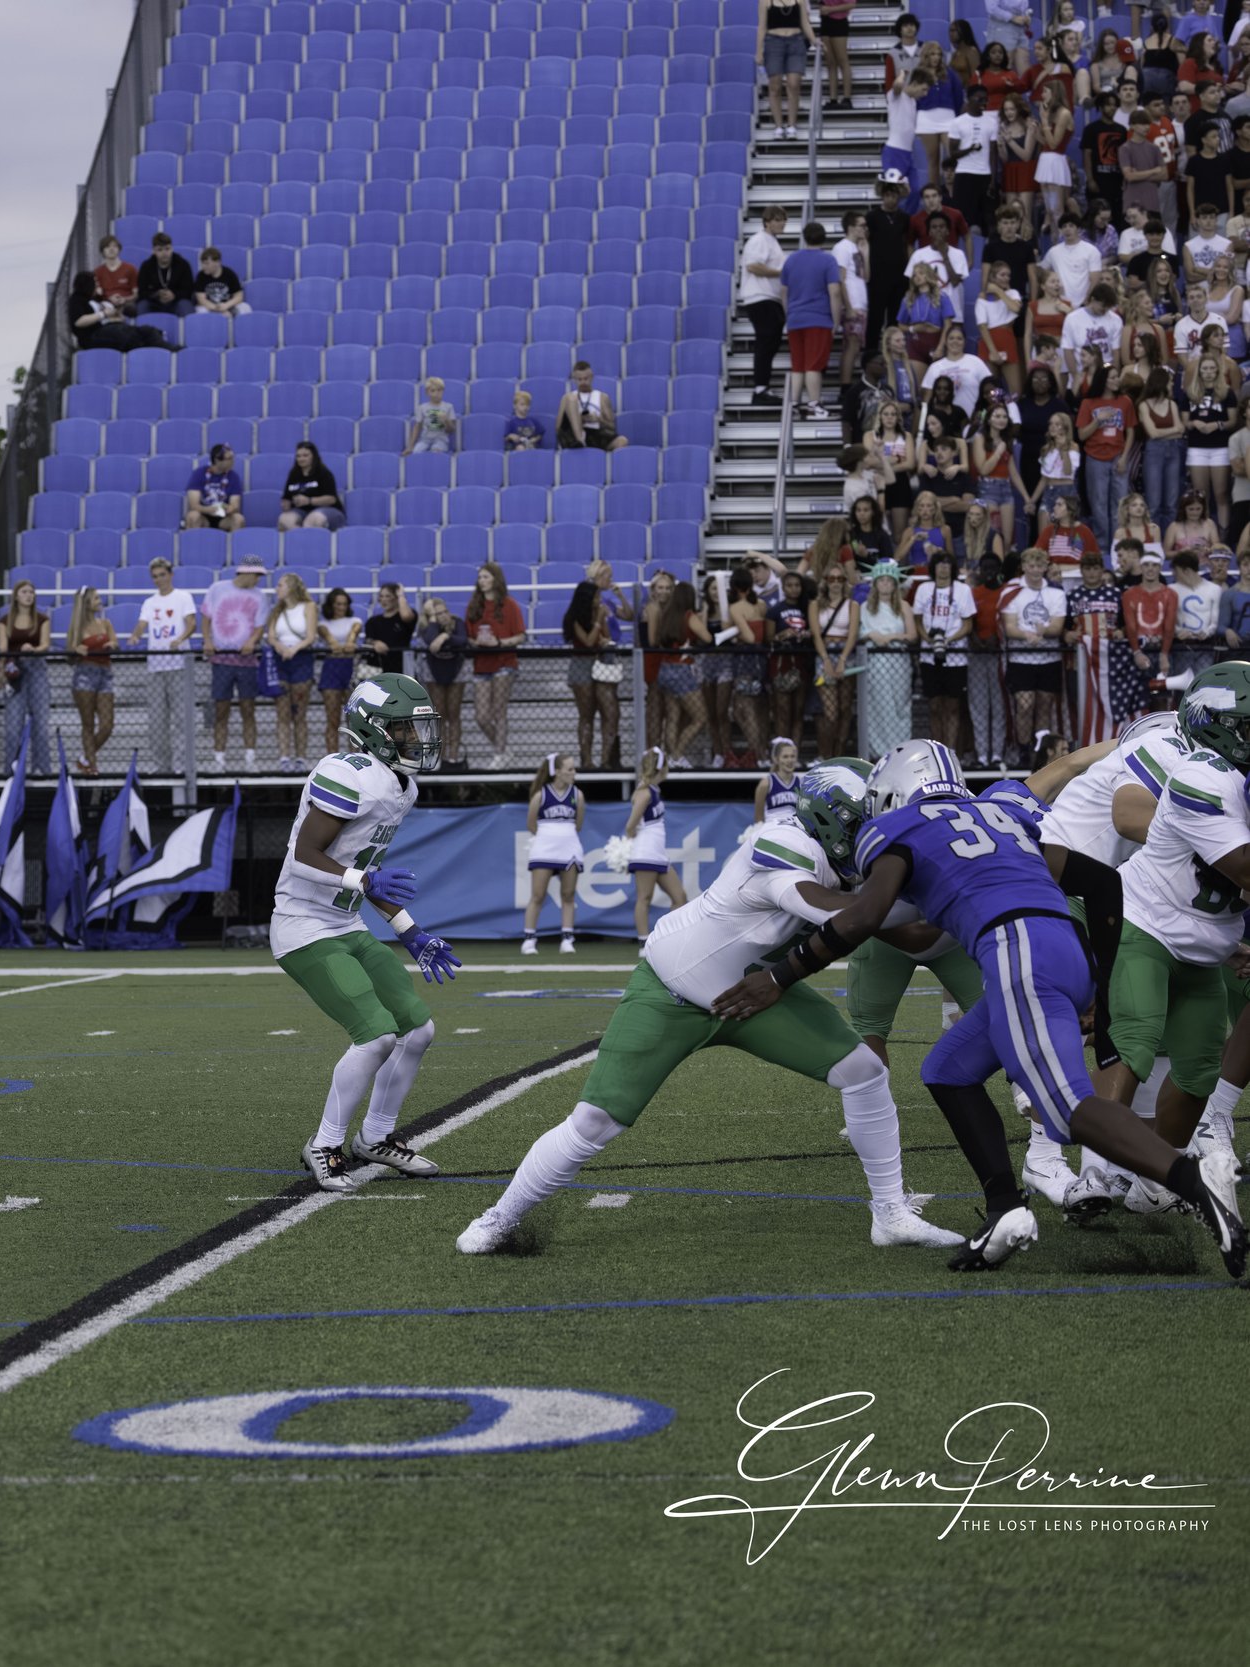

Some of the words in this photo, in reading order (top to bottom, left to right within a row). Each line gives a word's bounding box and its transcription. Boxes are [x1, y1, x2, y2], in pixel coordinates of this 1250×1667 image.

[1137, 601, 1164, 629] U
[1182, 594, 1204, 631] S
[922, 783, 951, 796] HARD
[918, 802, 1043, 860] 34
